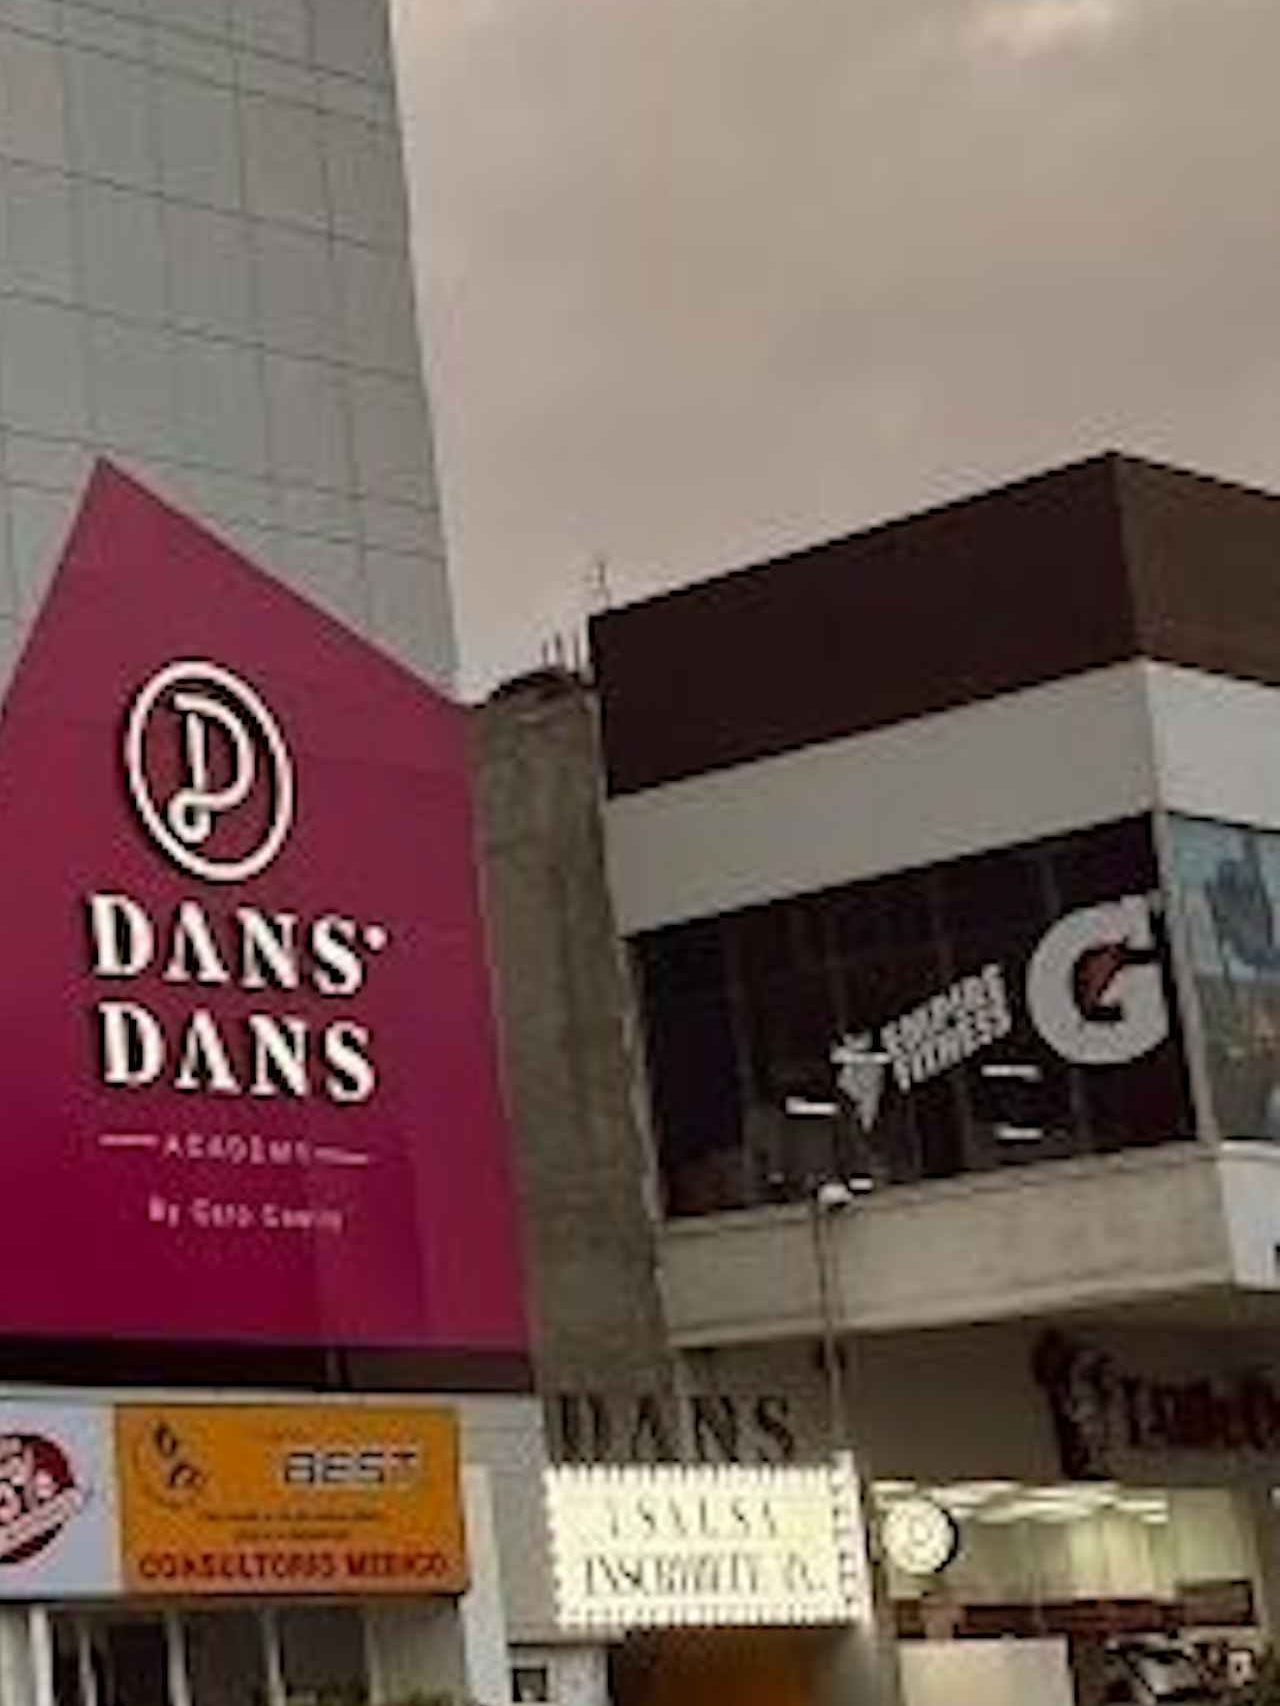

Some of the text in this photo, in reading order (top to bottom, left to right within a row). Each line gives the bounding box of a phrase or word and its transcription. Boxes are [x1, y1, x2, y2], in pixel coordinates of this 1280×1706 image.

[1026, 895, 1170, 1065] G
[96, 999, 380, 1105] DANS
[550, 1392, 795, 1463] DANS
